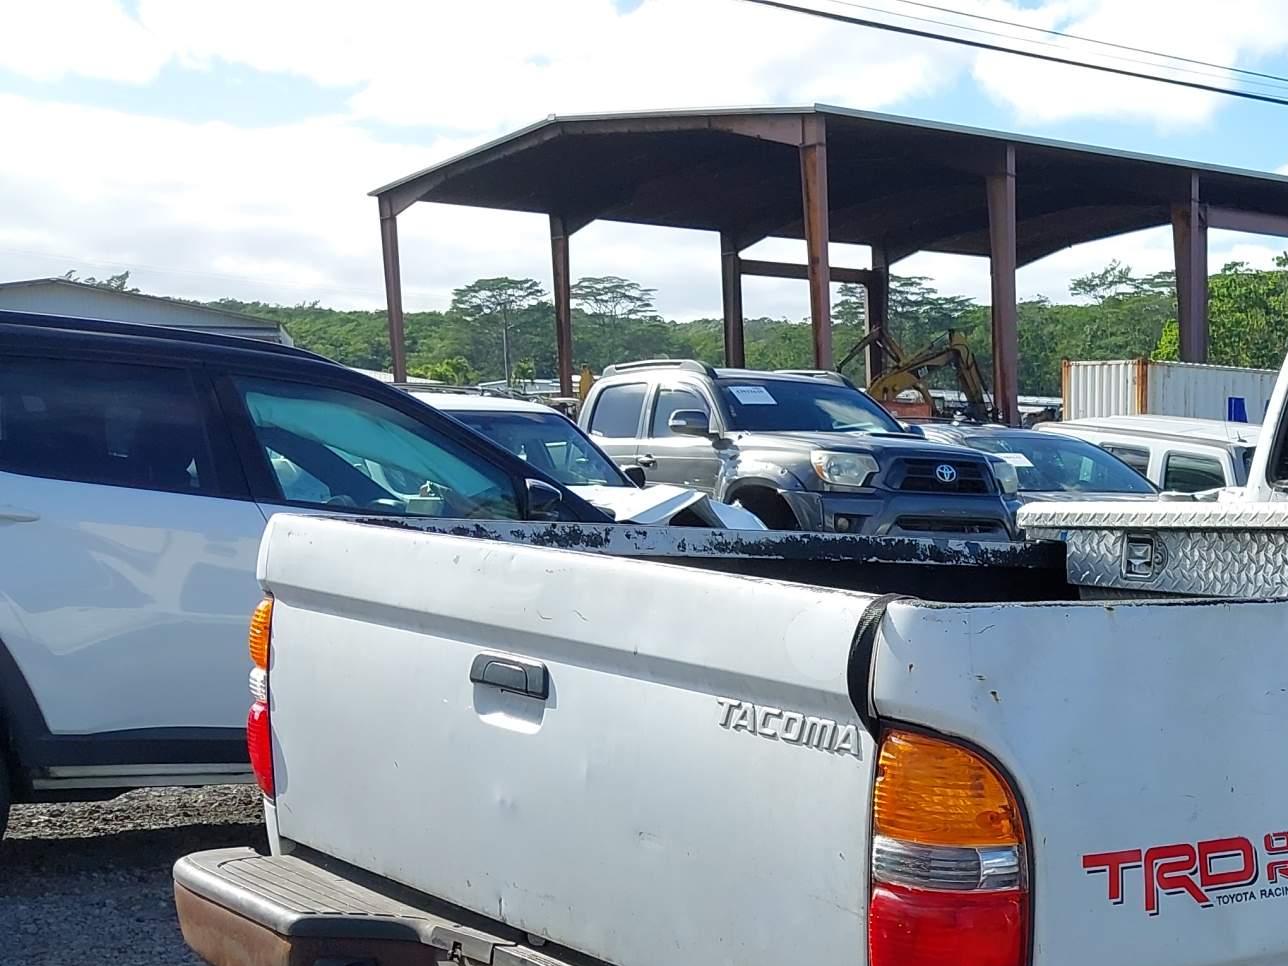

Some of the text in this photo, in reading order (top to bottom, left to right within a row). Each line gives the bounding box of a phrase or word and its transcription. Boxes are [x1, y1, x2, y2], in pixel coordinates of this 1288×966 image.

[716, 696, 864, 761] TACOMA
[1082, 836, 1259, 916] TRD
[1216, 892, 1256, 906] TOYOTA
